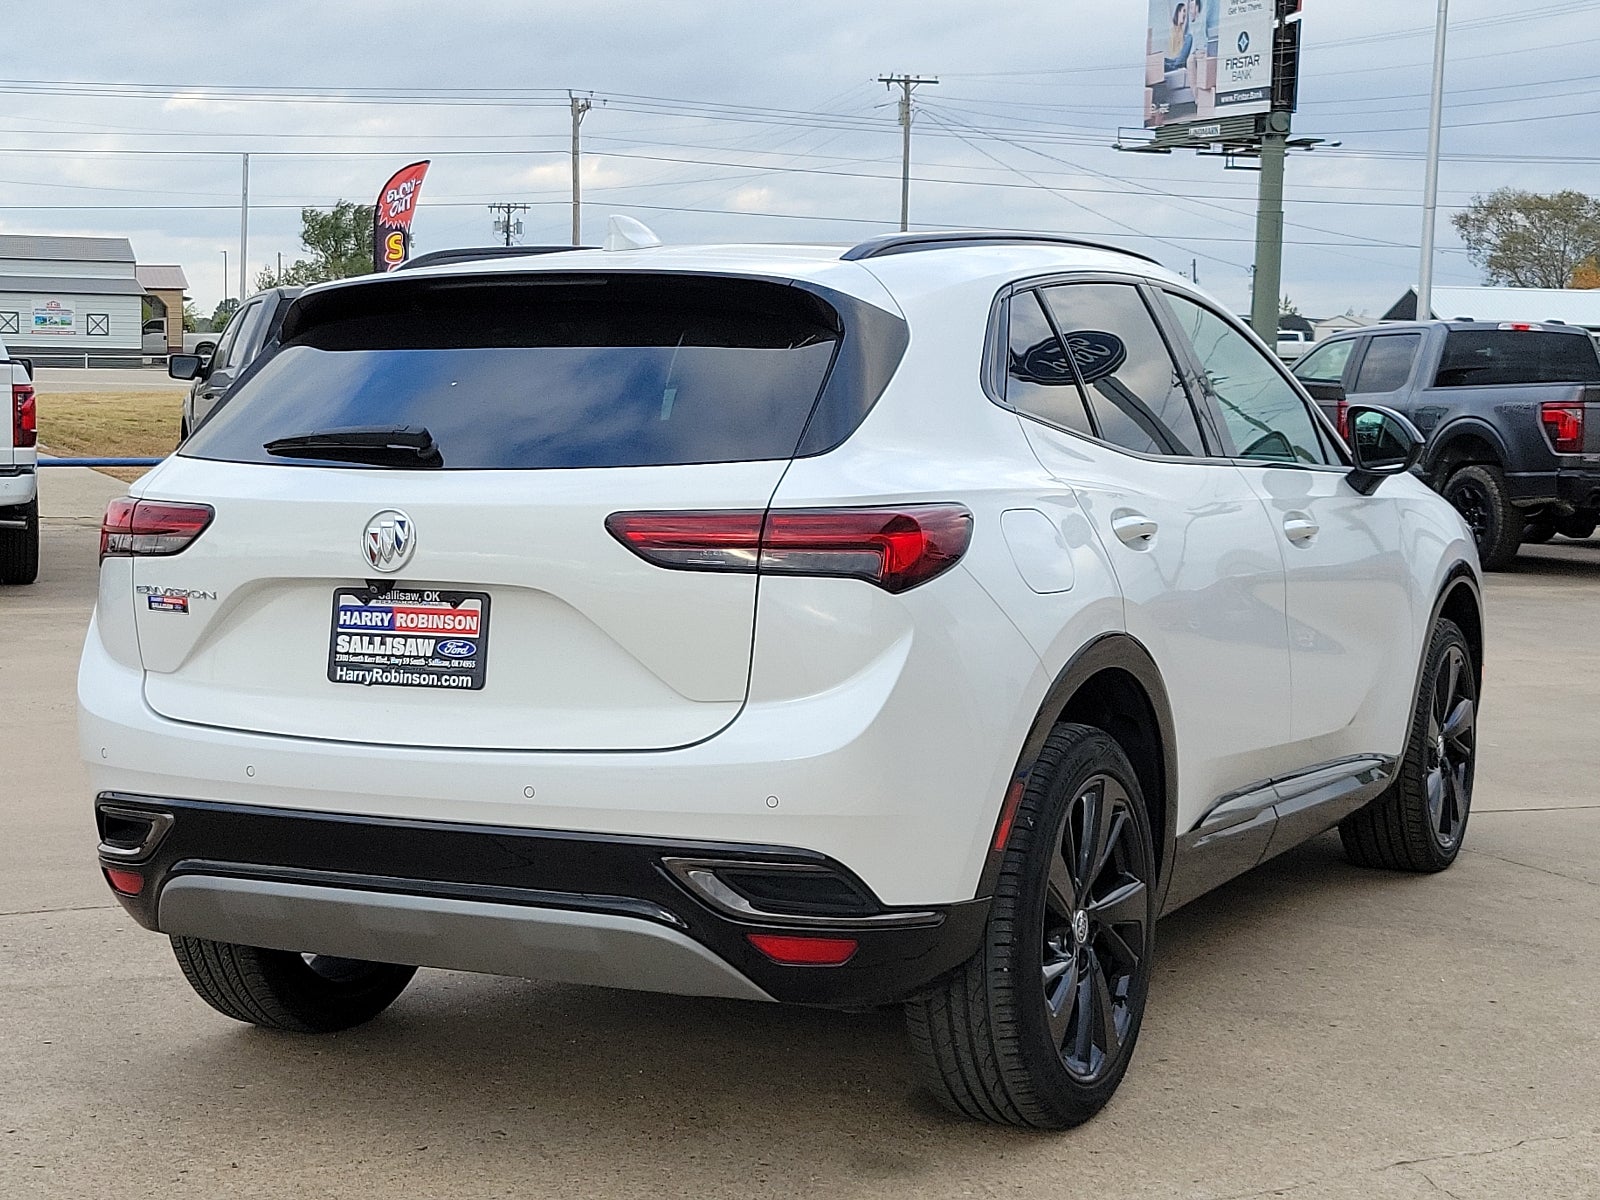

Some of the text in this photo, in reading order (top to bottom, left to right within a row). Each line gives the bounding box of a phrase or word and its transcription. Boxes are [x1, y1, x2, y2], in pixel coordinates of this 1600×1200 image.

[1225, 55, 1260, 70] FIRSTAR
[1231, 69, 1252, 81] BANK
[389, 193, 413, 217] OUT
[423, 591, 441, 602] OK
[339, 610, 477, 631] HARRY ROBINSON
[336, 635, 470, 657] SALLISAW Ford
[336, 666, 472, 688] HarryRobinson.com
